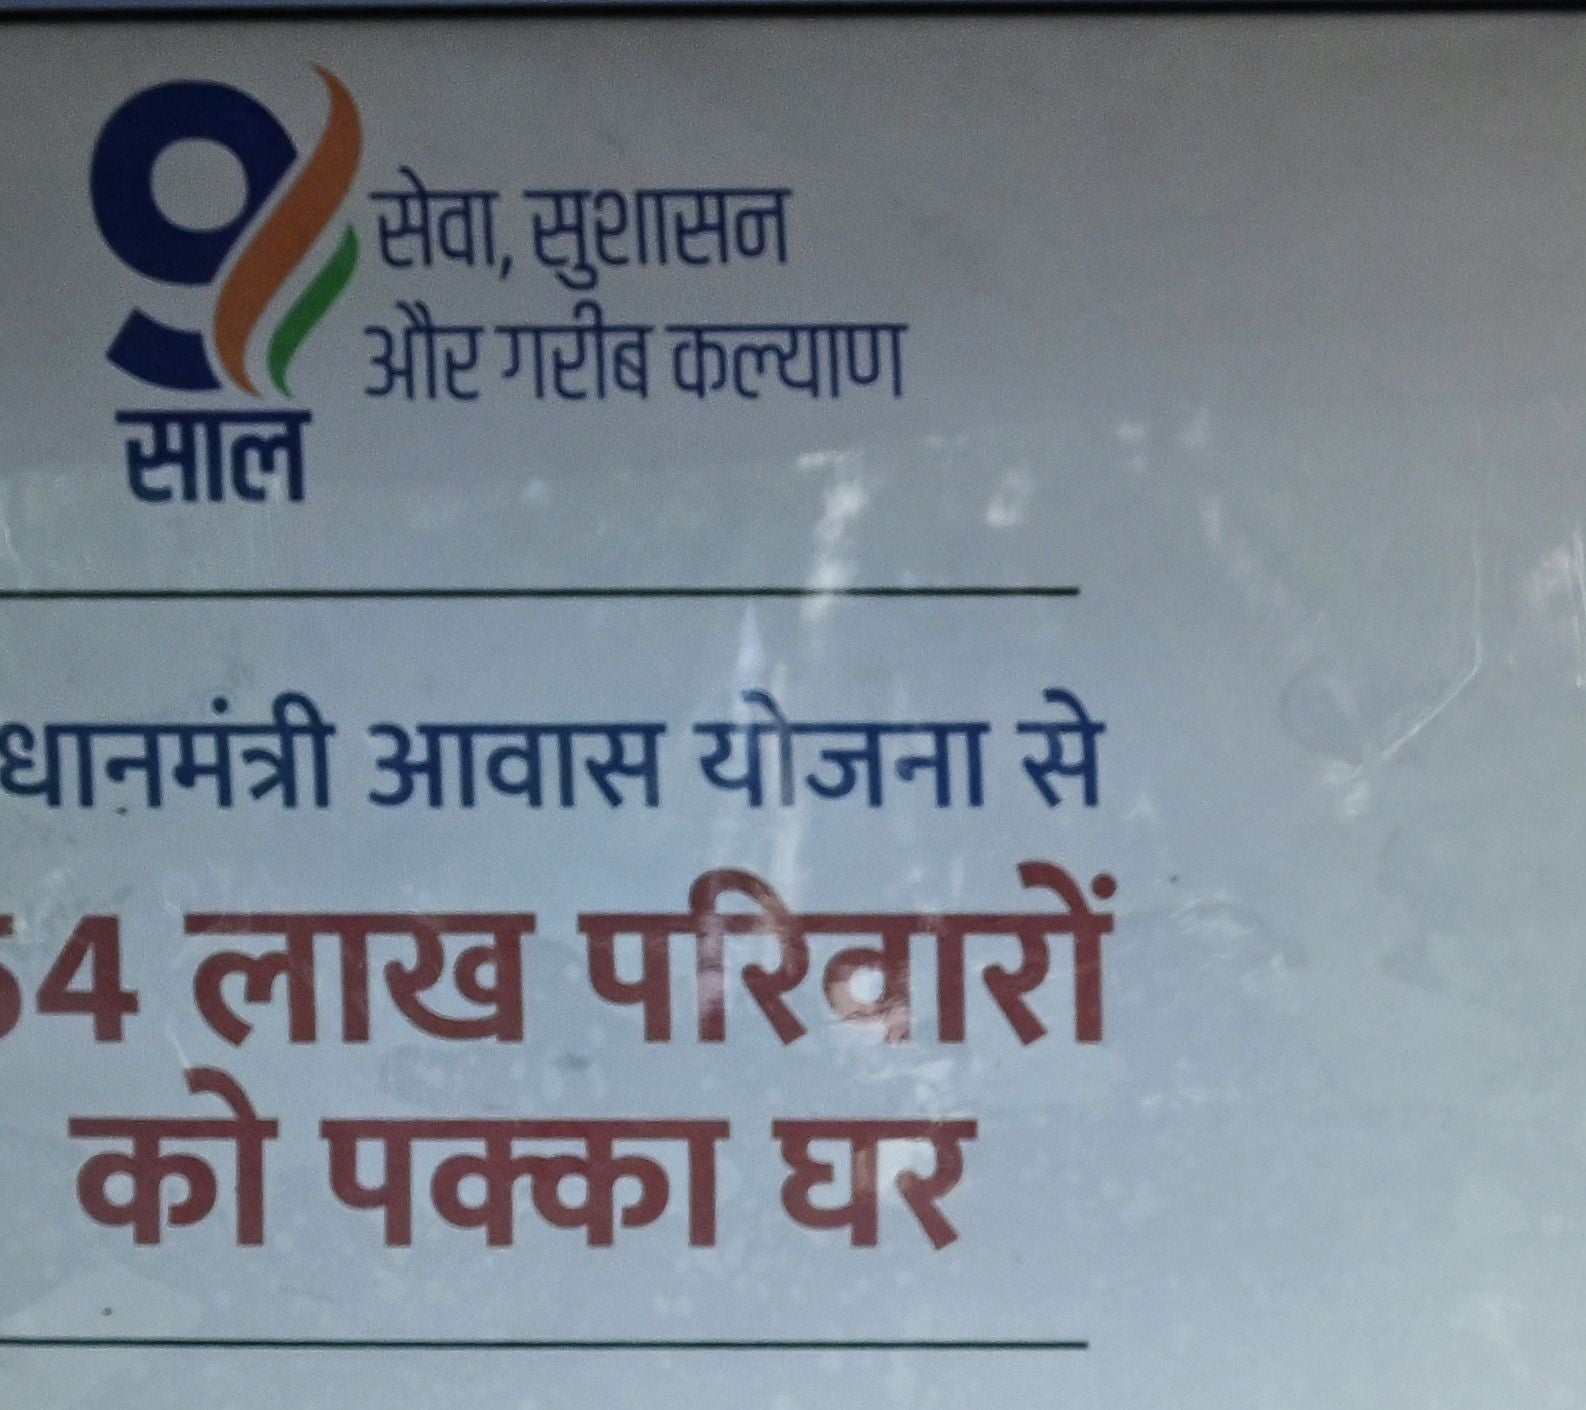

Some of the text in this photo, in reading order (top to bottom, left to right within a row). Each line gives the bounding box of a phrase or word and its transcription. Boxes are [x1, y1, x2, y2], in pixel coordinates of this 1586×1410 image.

[368, 167, 792, 291] सेवा, सुशासन
[362, 300, 909, 400] और गरीब कल्याण
[114, 410, 311, 503] साल
[367, 721, 667, 809] आवास
[693, 688, 990, 810] योजना
[1017, 688, 1107, 809] से
[0, 860, 1117, 1049] 4 लाख परिवारों
[68, 1066, 979, 1253] को पक्का घर
